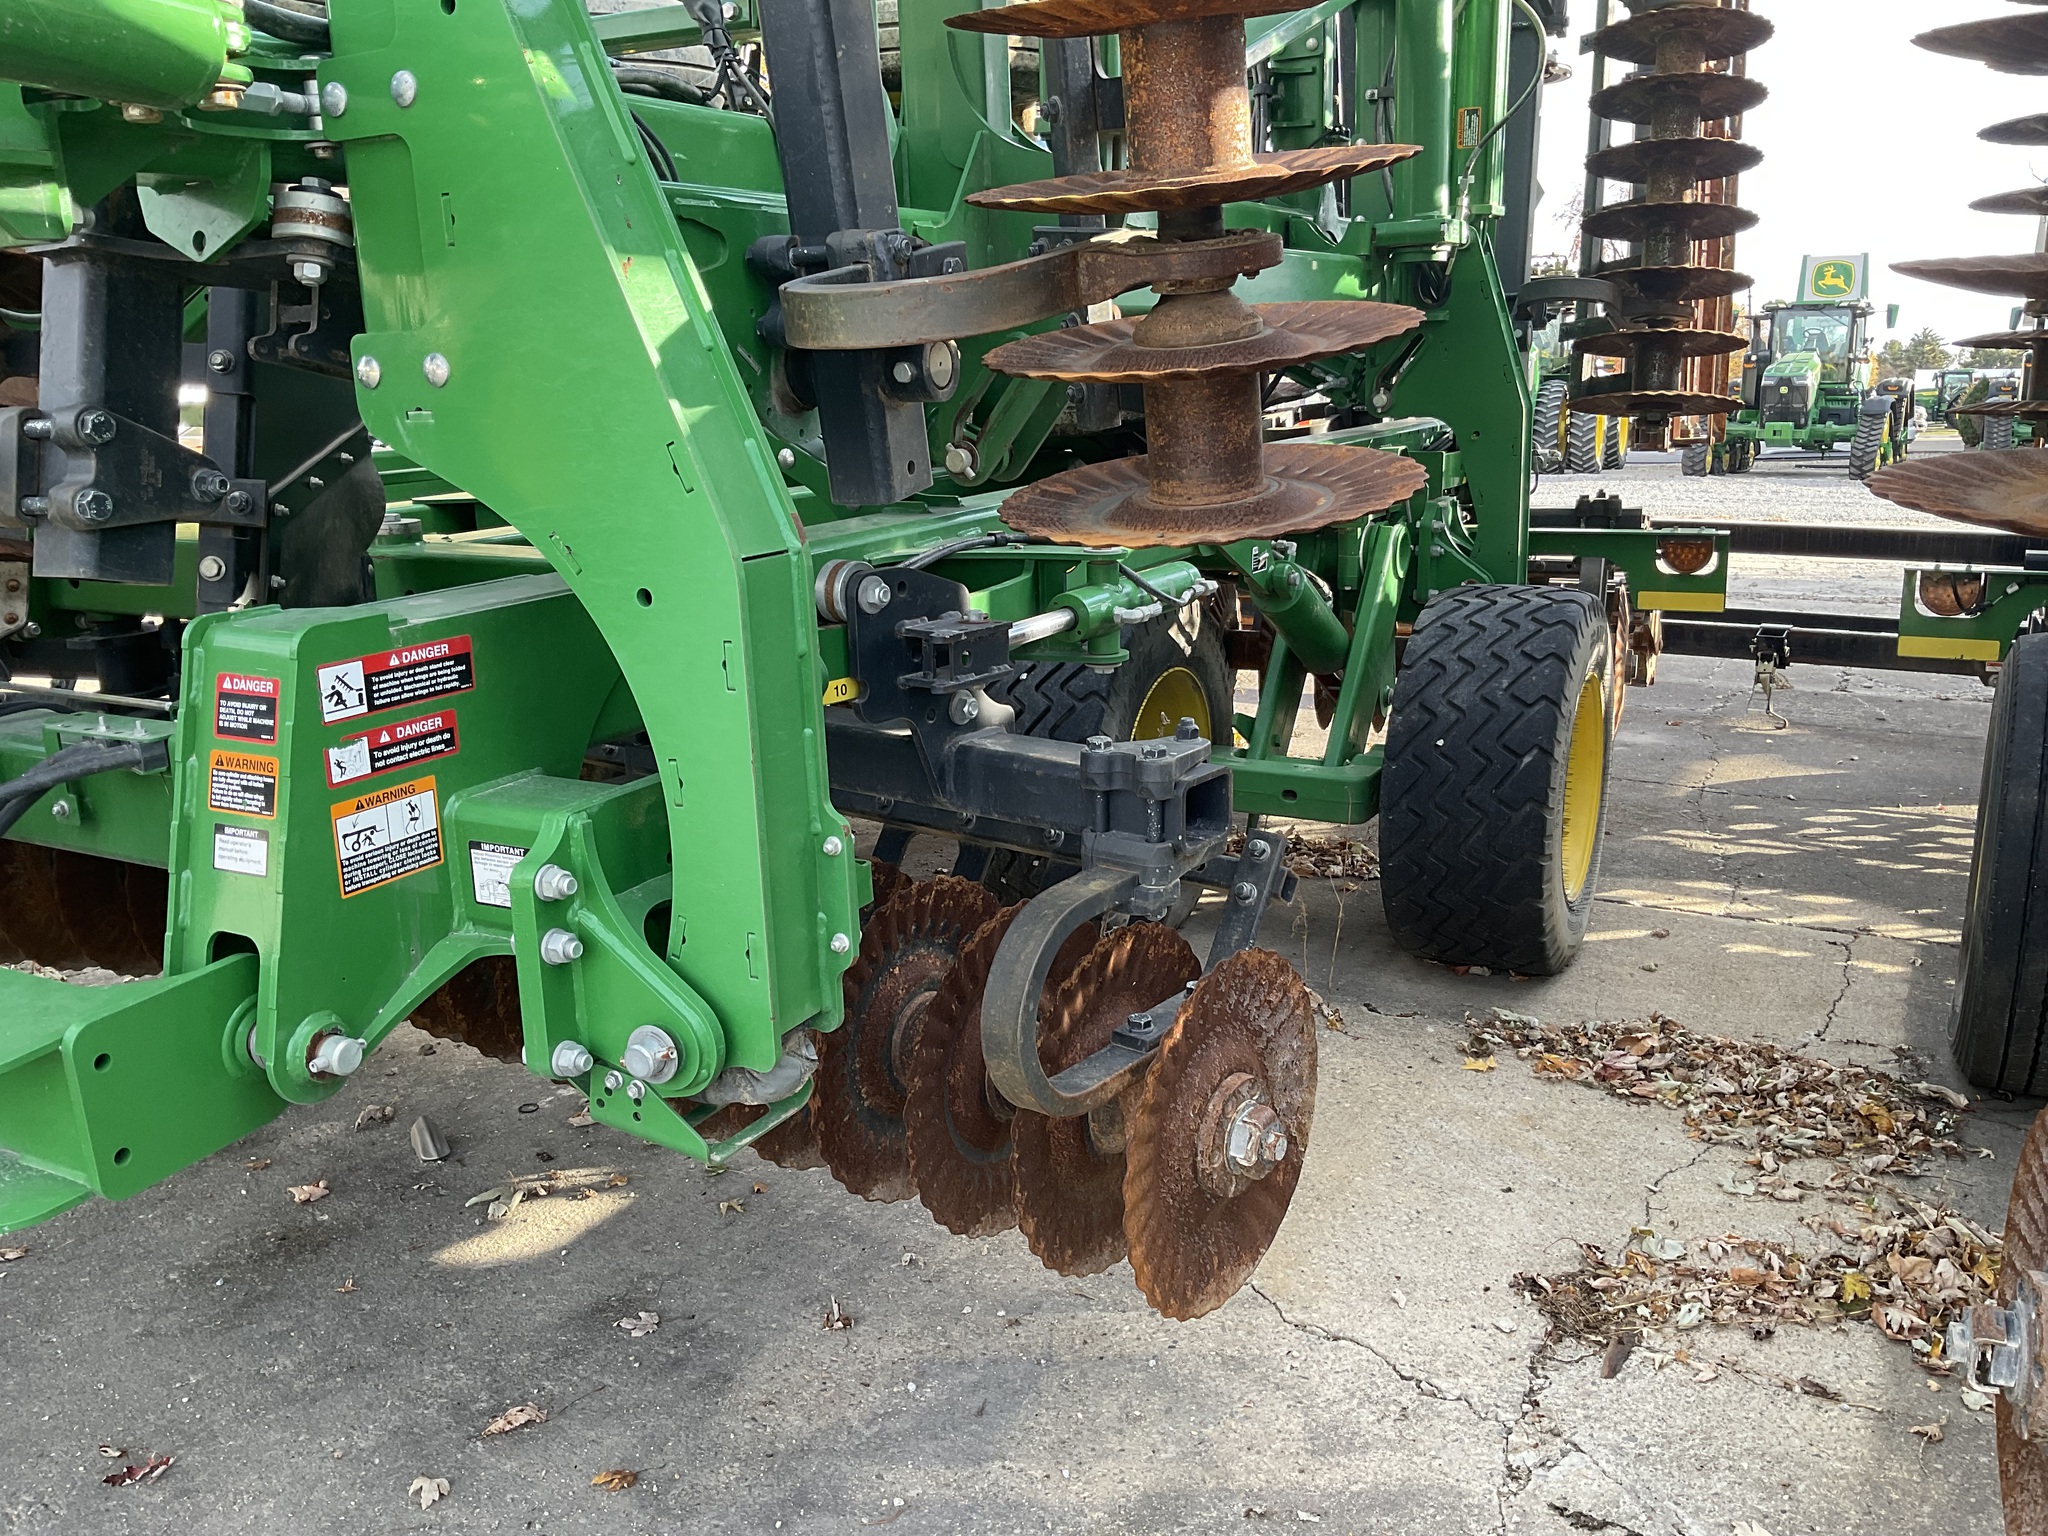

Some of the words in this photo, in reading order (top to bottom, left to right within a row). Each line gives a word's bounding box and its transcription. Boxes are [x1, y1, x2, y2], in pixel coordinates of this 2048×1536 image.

[402, 644, 449, 663] DANGER
[379, 680, 400, 688] machine
[415, 673, 428, 681] wings
[438, 667, 451, 676] being
[380, 673, 393, 681] avoid
[394, 670, 408, 679] injury
[430, 662, 442, 670] stand
[233, 678, 273, 693] DANGER
[375, 697, 390, 705] failure
[401, 691, 414, 699] allow
[415, 689, 429, 697] wings
[444, 680, 461, 690] rapidly.
[380, 687, 403, 696] unfolded.
[404, 681, 430, 690] Mechanical
[437, 674, 458, 683] hydraulic
[834, 684, 847, 697] 10
[253, 718, 274, 726] MACHINE
[396, 717, 442, 738] DANGER
[383, 747, 400, 756] avoid
[426, 735, 442, 744] death
[226, 757, 273, 773] WARNING
[386, 754, 408, 765] contact
[410, 748, 430, 758] electric
[365, 784, 415, 807] WARNING
[225, 827, 258, 838] IMPORTANT
[343, 861, 366, 872] machine
[368, 853, 392, 864] lowering
[419, 836, 437, 846] control
[350, 855, 364, 864] avoid
[365, 849, 384, 858] serious
[385, 843, 399, 853] injury
[407, 835, 420, 844] death
[481, 843, 524, 856] IMPORTANT
[344, 869, 361, 879] during
[389, 853, 407, 863] CLOSE
[408, 848, 424, 857] lockup
[425, 843, 438, 851] valve
[353, 871, 377, 882] INSTALL
[379, 862, 403, 873] cylinder
[422, 850, 436, 858] locks
[345, 882, 361, 891] before
[362, 873, 391, 887] transporting
[398, 862, 419, 873] servicing
